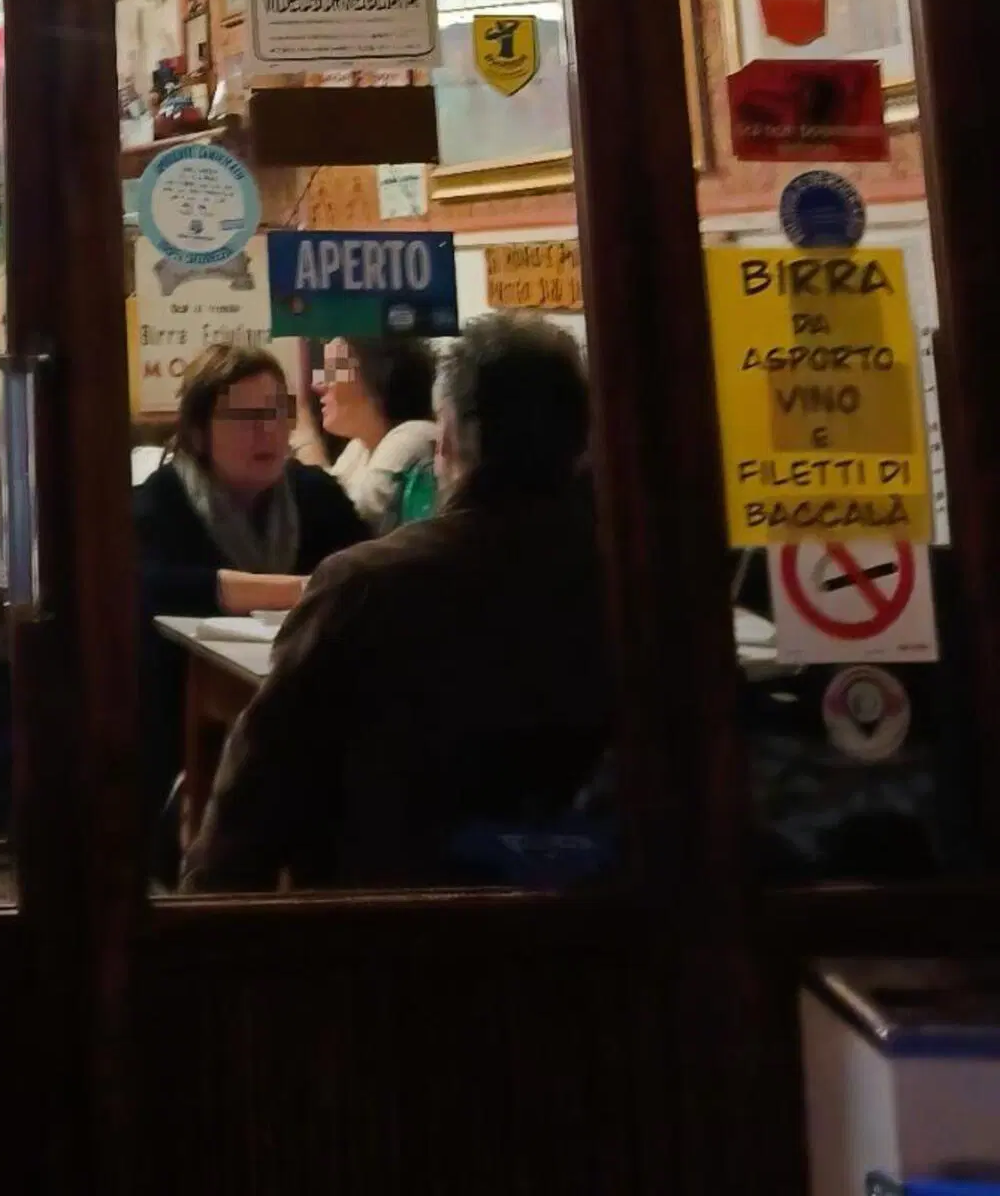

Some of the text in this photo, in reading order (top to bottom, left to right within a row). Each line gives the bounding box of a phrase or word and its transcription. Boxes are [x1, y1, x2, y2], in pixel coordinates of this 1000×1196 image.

[295, 240, 432, 290] APERTO
[740, 259, 895, 296] BIRRA
[792, 313, 830, 335] DA
[741, 347, 895, 372] ASPORTO
[776, 384, 861, 414] VINO
[812, 426, 830, 448] E
[737, 459, 911, 486] FILETTI DI
[746, 493, 910, 528] BACCALÀ
